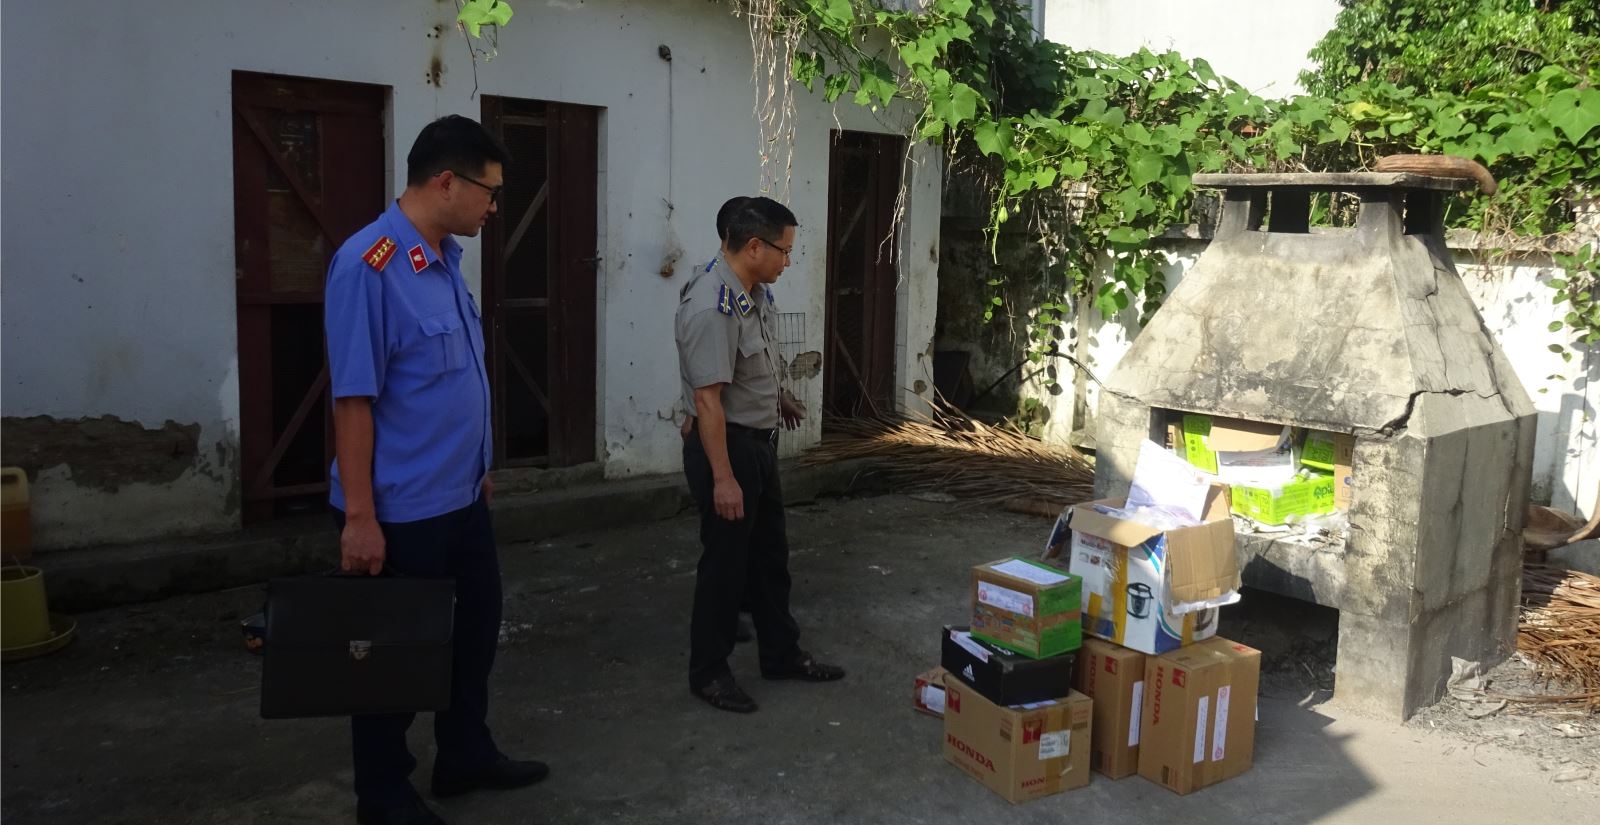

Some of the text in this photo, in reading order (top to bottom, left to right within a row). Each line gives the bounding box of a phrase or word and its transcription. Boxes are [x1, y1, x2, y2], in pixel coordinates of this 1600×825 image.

[1088, 655, 1097, 699] HOND
[1152, 665, 1164, 726] HONDA
[946, 733, 996, 773] HONDA
[1021, 775, 1049, 789] HON
